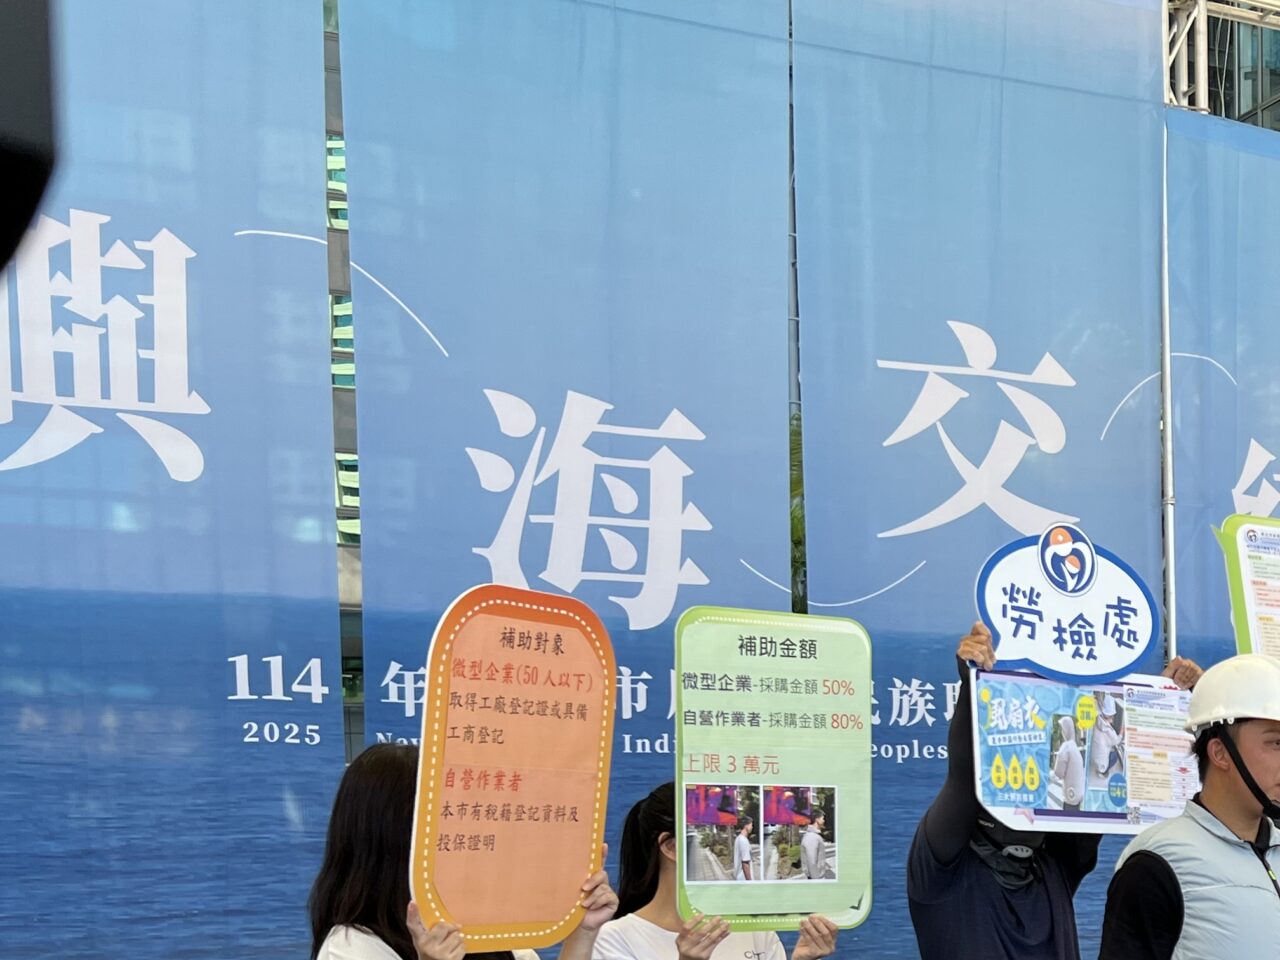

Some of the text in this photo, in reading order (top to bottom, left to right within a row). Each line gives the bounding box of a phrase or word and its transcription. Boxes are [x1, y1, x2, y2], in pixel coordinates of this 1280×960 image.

[465, 388, 714, 630] 海
[876, 320, 1080, 538] 交
[1001, 582, 1140, 661] 勞檢處
[500, 626, 565, 656] 補助對象
[738, 634, 818, 660] 補助金額
[227, 654, 329, 703] 114
[380, 660, 427, 717] 年
[822, 679, 855, 696] 50%
[447, 724, 505, 744] 工商登記
[831, 713, 864, 730] 80%
[242, 721, 321, 745] 2025
[871, 739, 949, 764] eoples
[683, 753, 780, 775] 上限 3 萬元
[444, 768, 523, 792] 自營作業者
[437, 833, 496, 852] 投保證明
